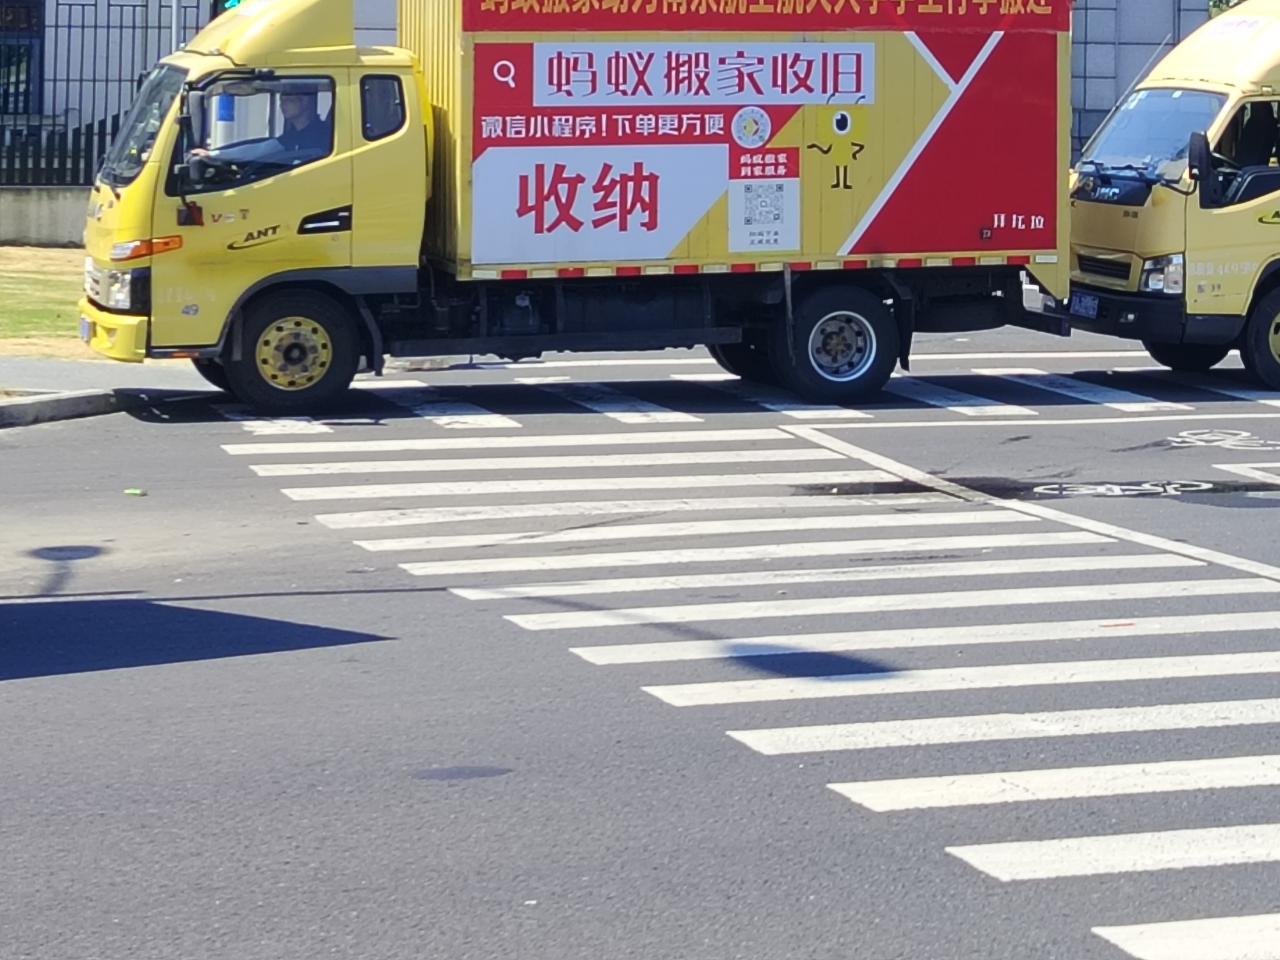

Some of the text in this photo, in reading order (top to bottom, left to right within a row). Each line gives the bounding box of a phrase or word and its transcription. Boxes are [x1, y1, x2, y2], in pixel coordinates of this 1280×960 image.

[546, 49, 863, 98] 蚂蚁搬家收旧
[516, 162, 661, 235] 收纳
[243, 224, 281, 243] ANT
